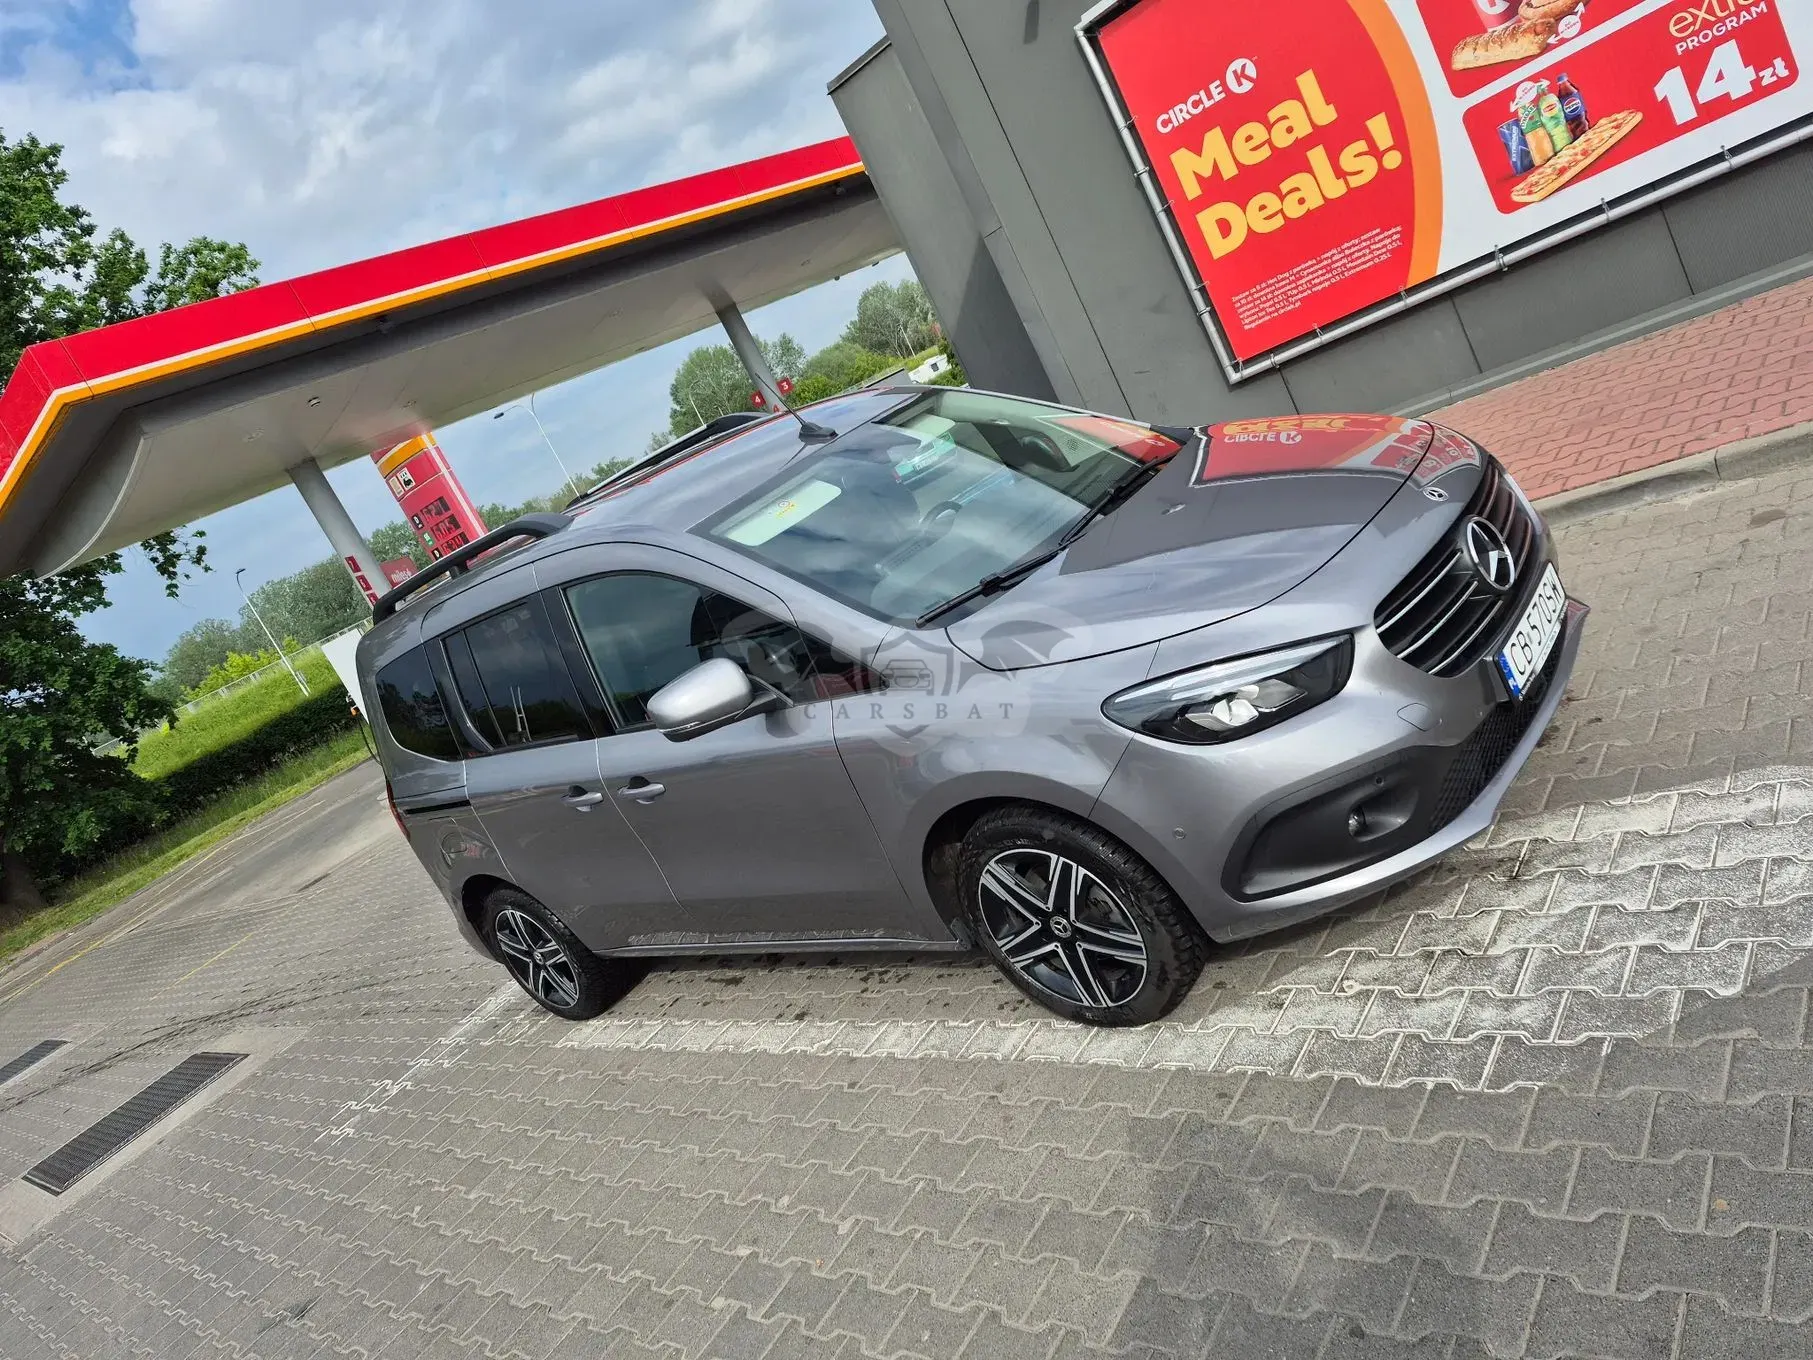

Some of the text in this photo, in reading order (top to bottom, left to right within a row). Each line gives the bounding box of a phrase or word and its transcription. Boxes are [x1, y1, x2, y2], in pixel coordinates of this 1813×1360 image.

[1675, 1, 1768, 56] PROGRAM
[1156, 60, 1257, 134] CIRCLE K
[1169, 68, 1337, 201] Meal
[1195, 112, 1402, 260] Deals!
[781, 381, 789, 390] 3
[1510, 630, 1533, 675] CB
